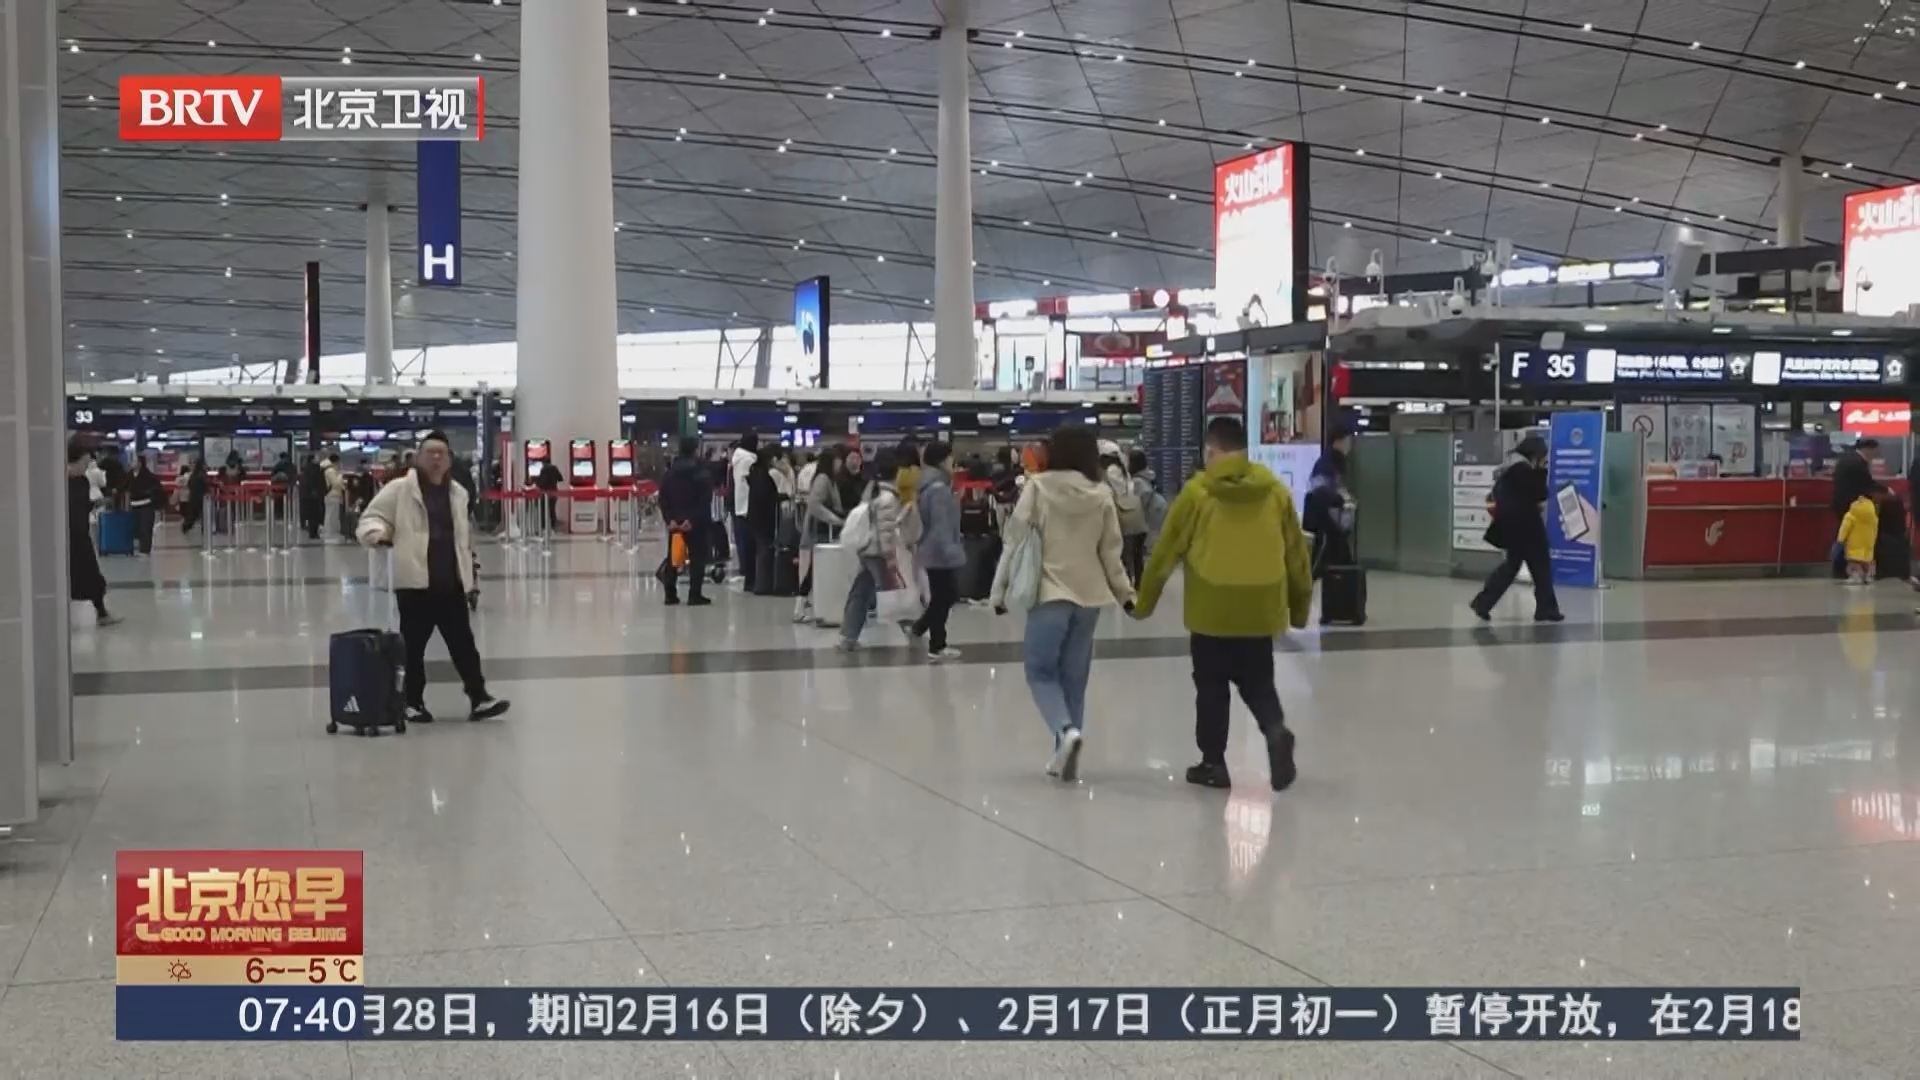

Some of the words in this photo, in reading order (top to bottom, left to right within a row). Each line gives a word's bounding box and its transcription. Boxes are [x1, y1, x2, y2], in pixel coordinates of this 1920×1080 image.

[423, 243, 455, 281] H
[1511, 351, 1530, 379] F
[1546, 353, 1576, 379] 35
